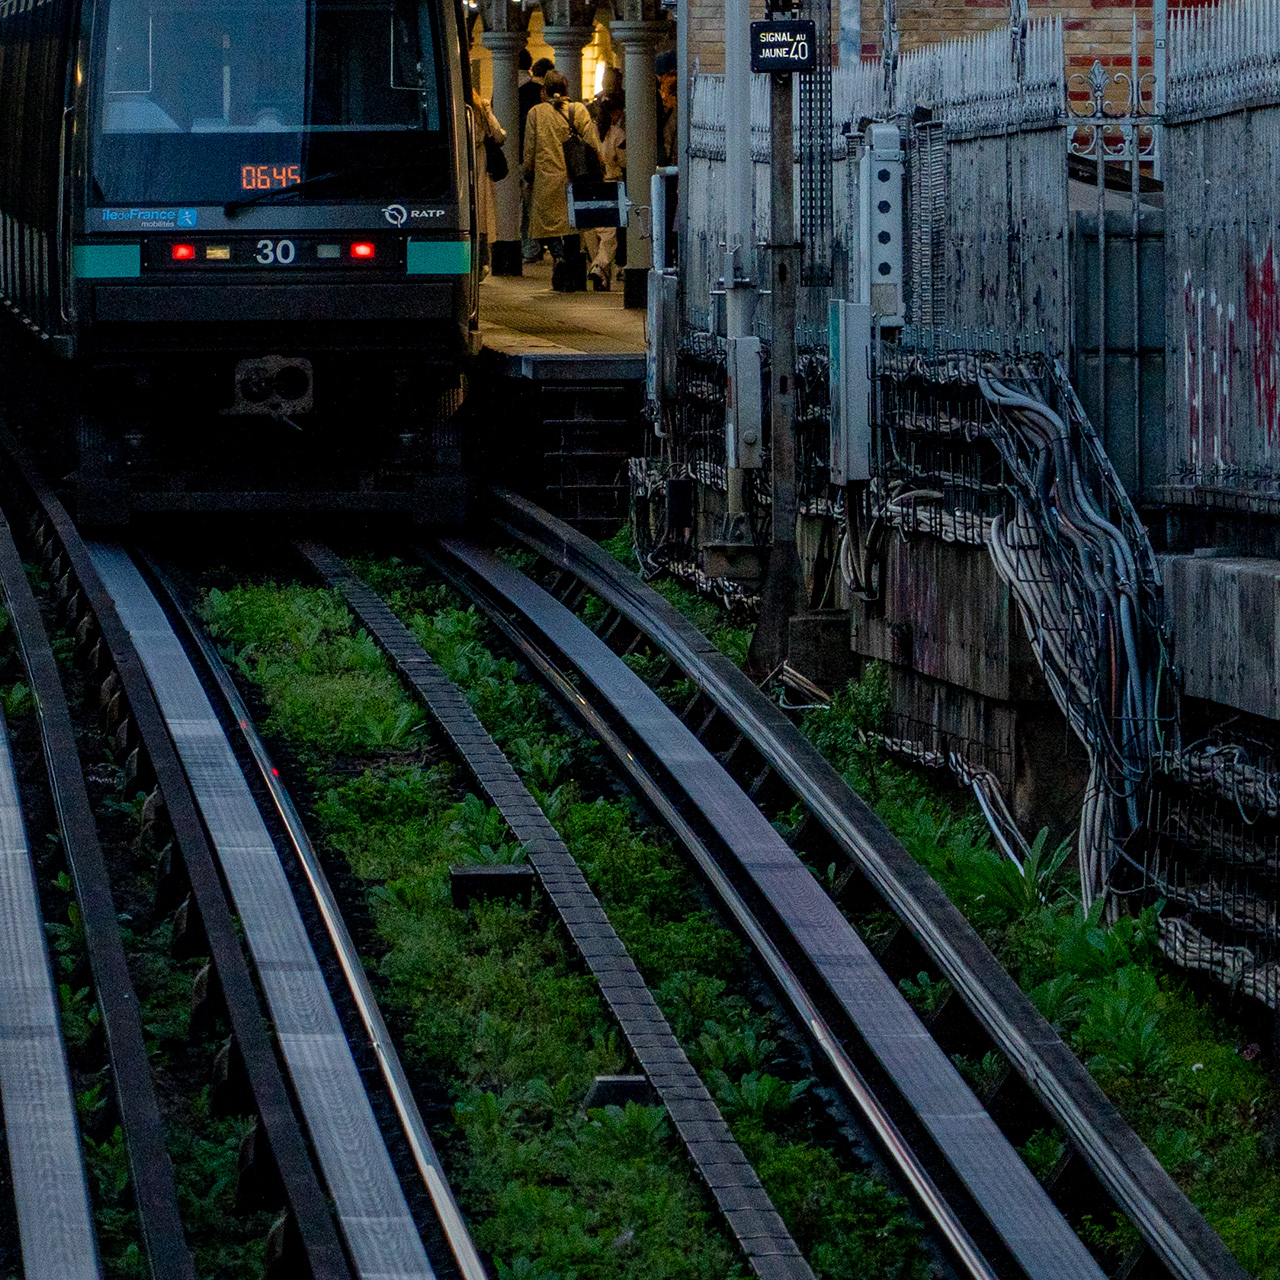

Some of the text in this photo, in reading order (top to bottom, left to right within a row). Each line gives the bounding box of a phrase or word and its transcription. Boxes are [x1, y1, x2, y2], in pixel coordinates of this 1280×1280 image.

[760, 32, 806, 42] SIGNAL AU
[759, 41, 808, 60] JAUNE 40
[242, 166, 301, 189] 0645
[410, 209, 446, 218] RATP
[255, 239, 296, 264] 30
